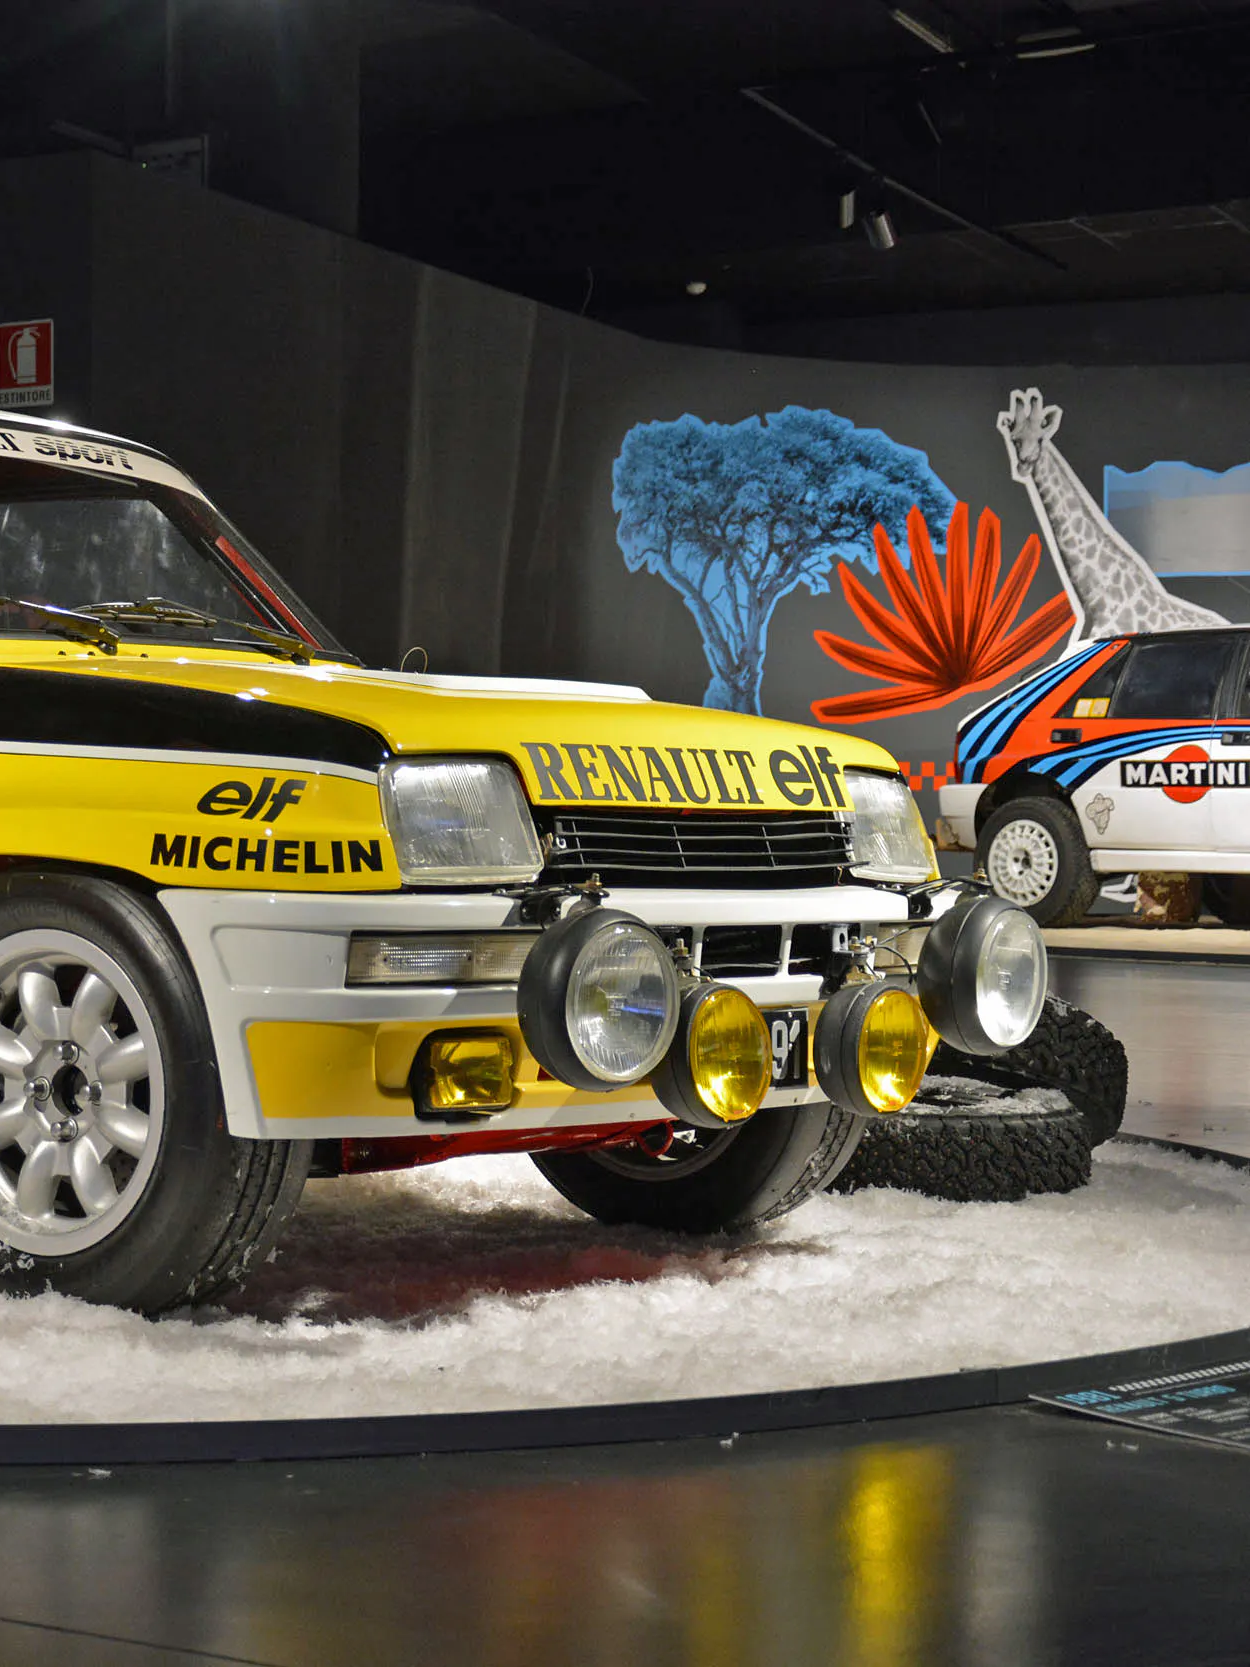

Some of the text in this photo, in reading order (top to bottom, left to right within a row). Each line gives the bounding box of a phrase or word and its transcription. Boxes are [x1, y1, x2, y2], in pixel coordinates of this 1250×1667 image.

[32, 436, 135, 471] sport
[520, 741, 846, 808] RENAULT elf
[1125, 762, 1247, 786] MARTINI
[196, 777, 307, 823] elf
[150, 833, 383, 874] MICHELIN
